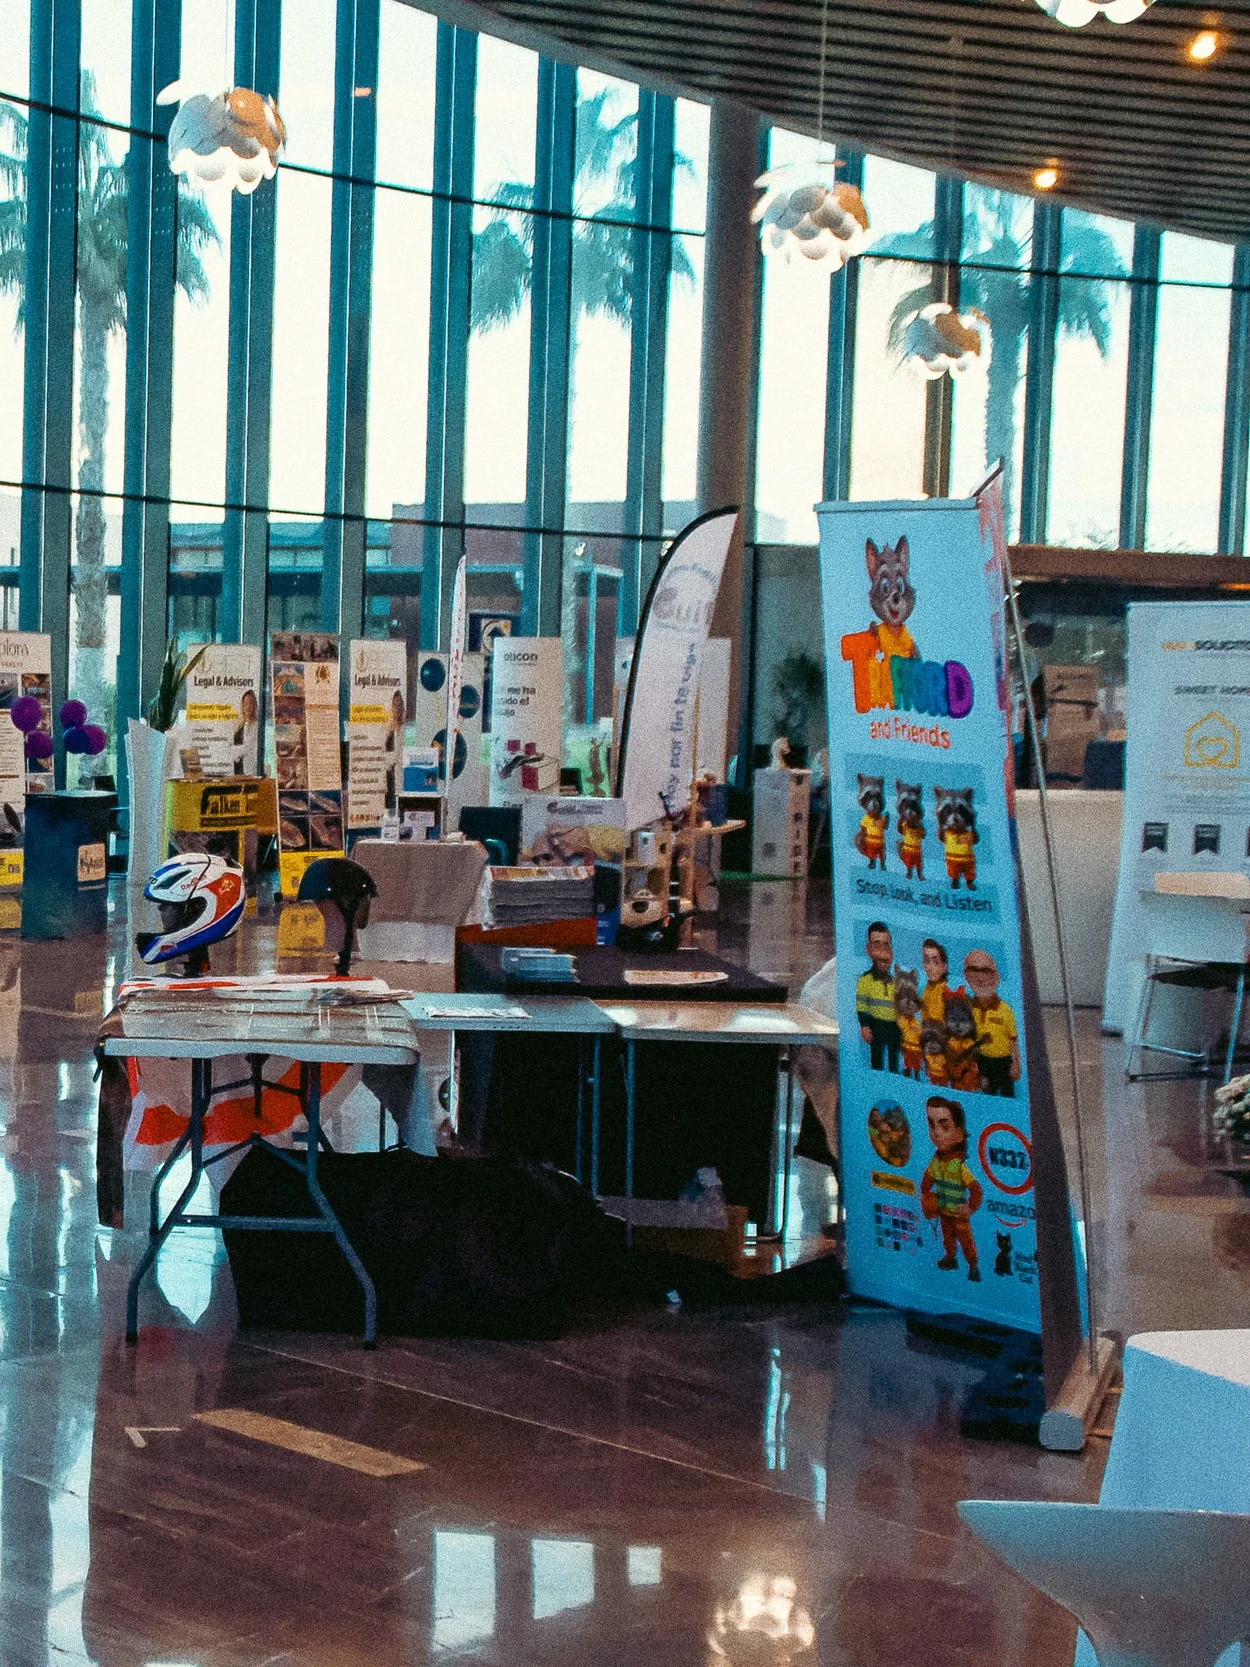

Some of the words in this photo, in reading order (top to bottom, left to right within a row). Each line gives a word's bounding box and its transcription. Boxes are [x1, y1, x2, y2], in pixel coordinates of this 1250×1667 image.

[194, 675, 215, 689] Legal
[215, 676, 222, 686] &
[223, 675, 254, 688] Advisors
[354, 673, 371, 689] Legal
[869, 717, 891, 739] and
[893, 716, 951, 749] Friends
[920, 891, 942, 908] and
[944, 893, 993, 912] Listen
[987, 1200, 1036, 1221] amazo
